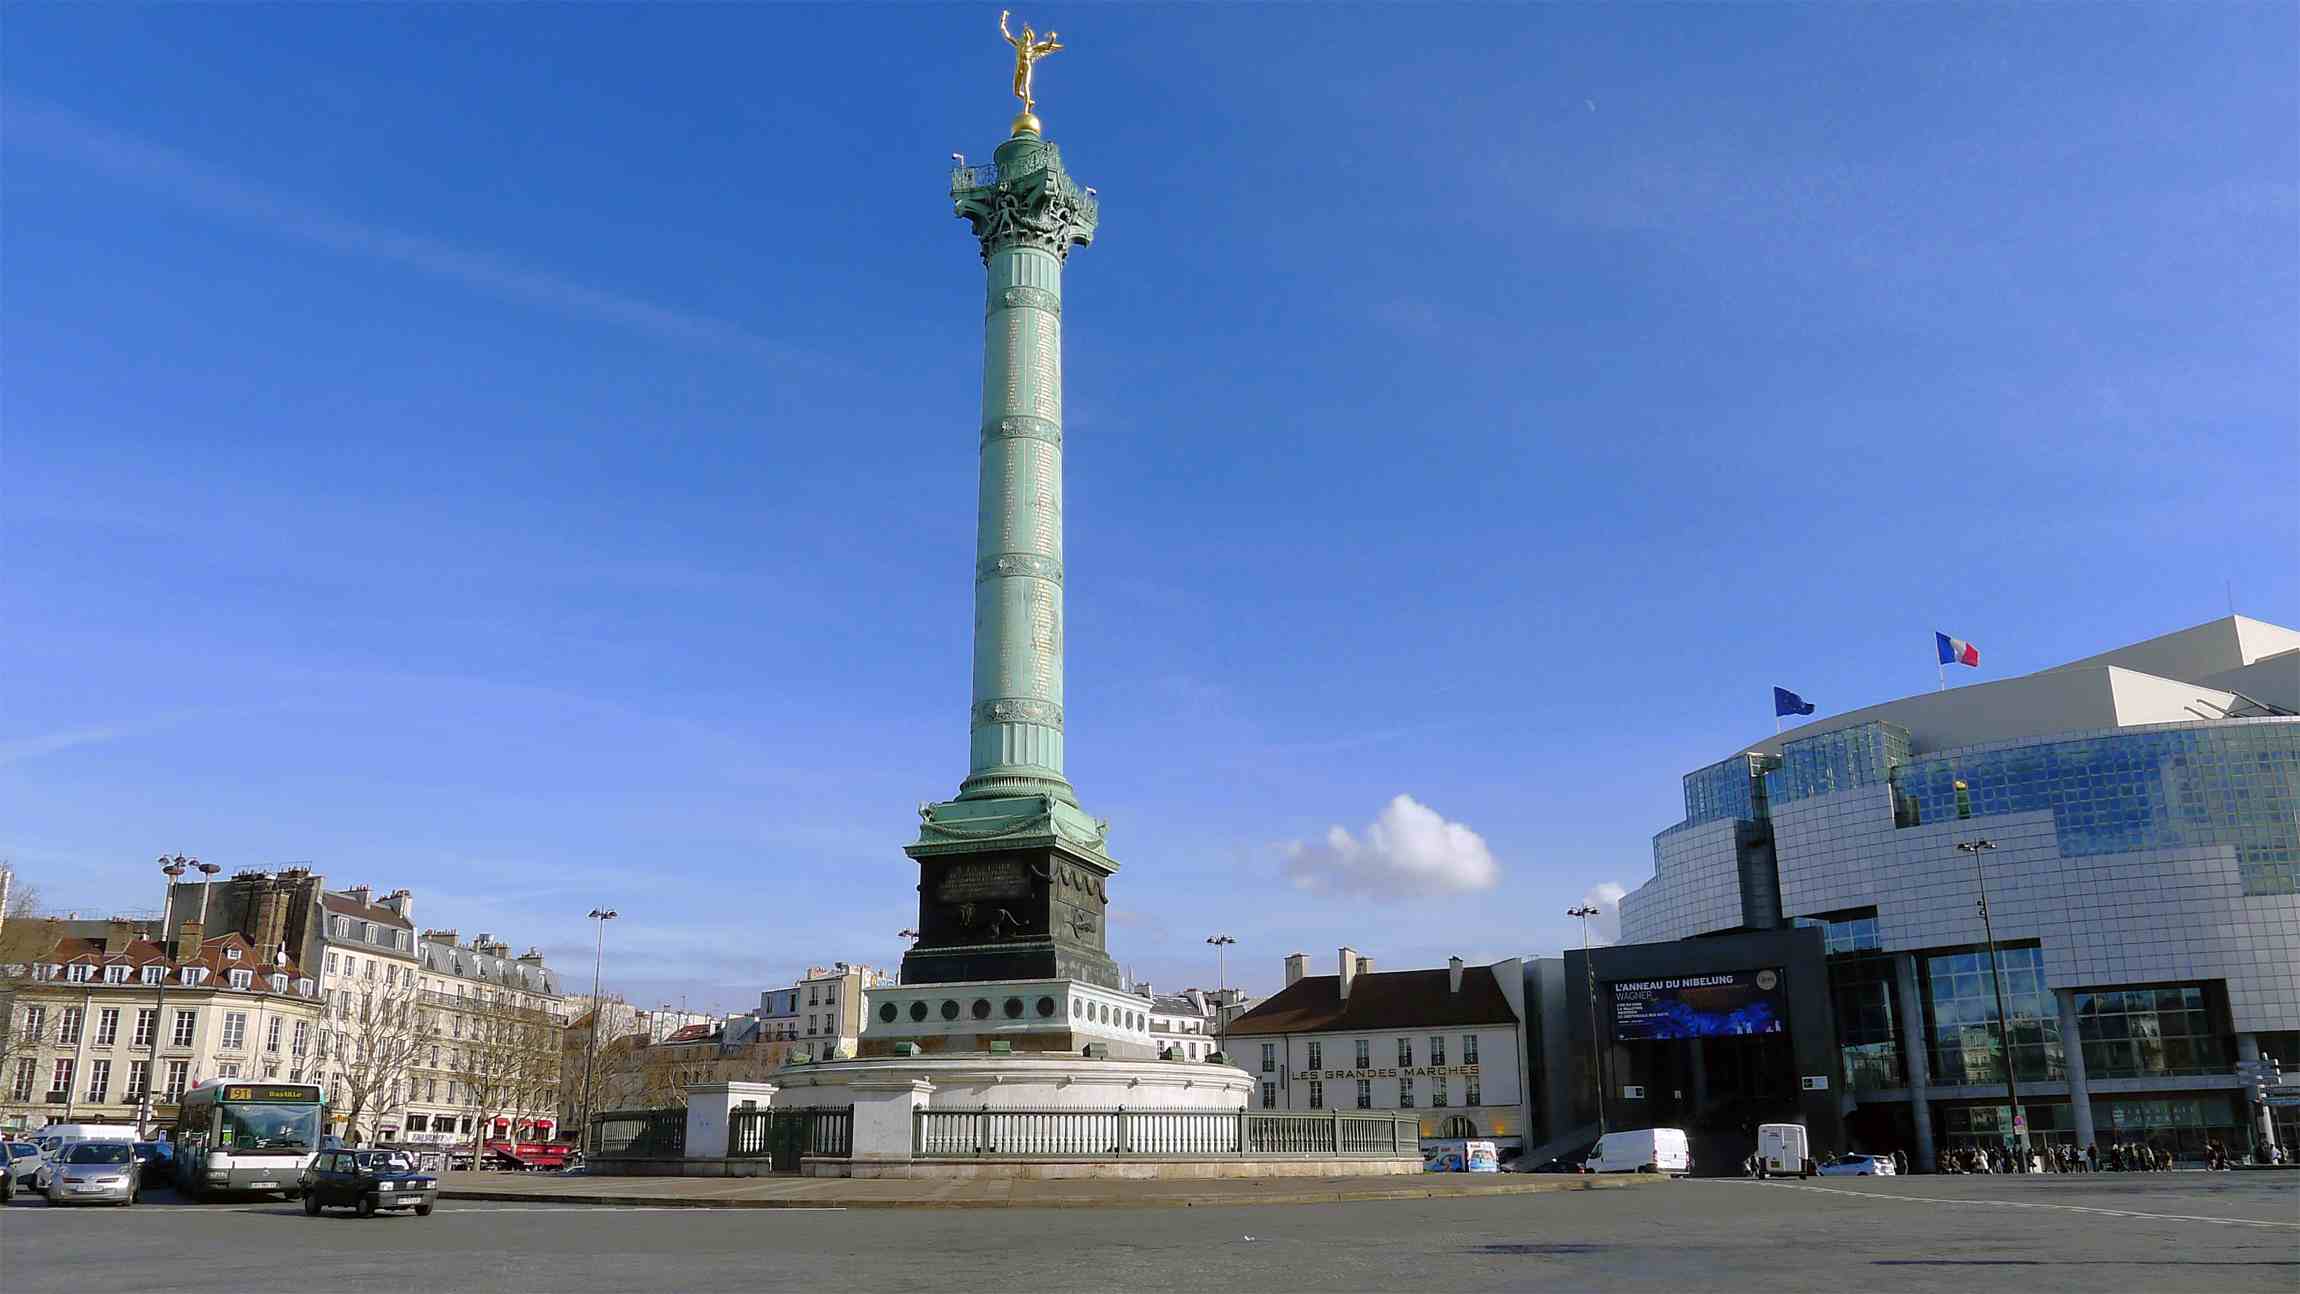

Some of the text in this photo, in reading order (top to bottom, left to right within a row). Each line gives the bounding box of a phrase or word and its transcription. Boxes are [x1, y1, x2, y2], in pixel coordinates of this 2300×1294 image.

[1615, 975, 1734, 992] L'ANNEAU DU NIBELUNG
[1616, 990, 1652, 1001] WAGNER
[1292, 1070, 1318, 1081] LES
[1324, 1068, 1397, 1080] GRANDES
